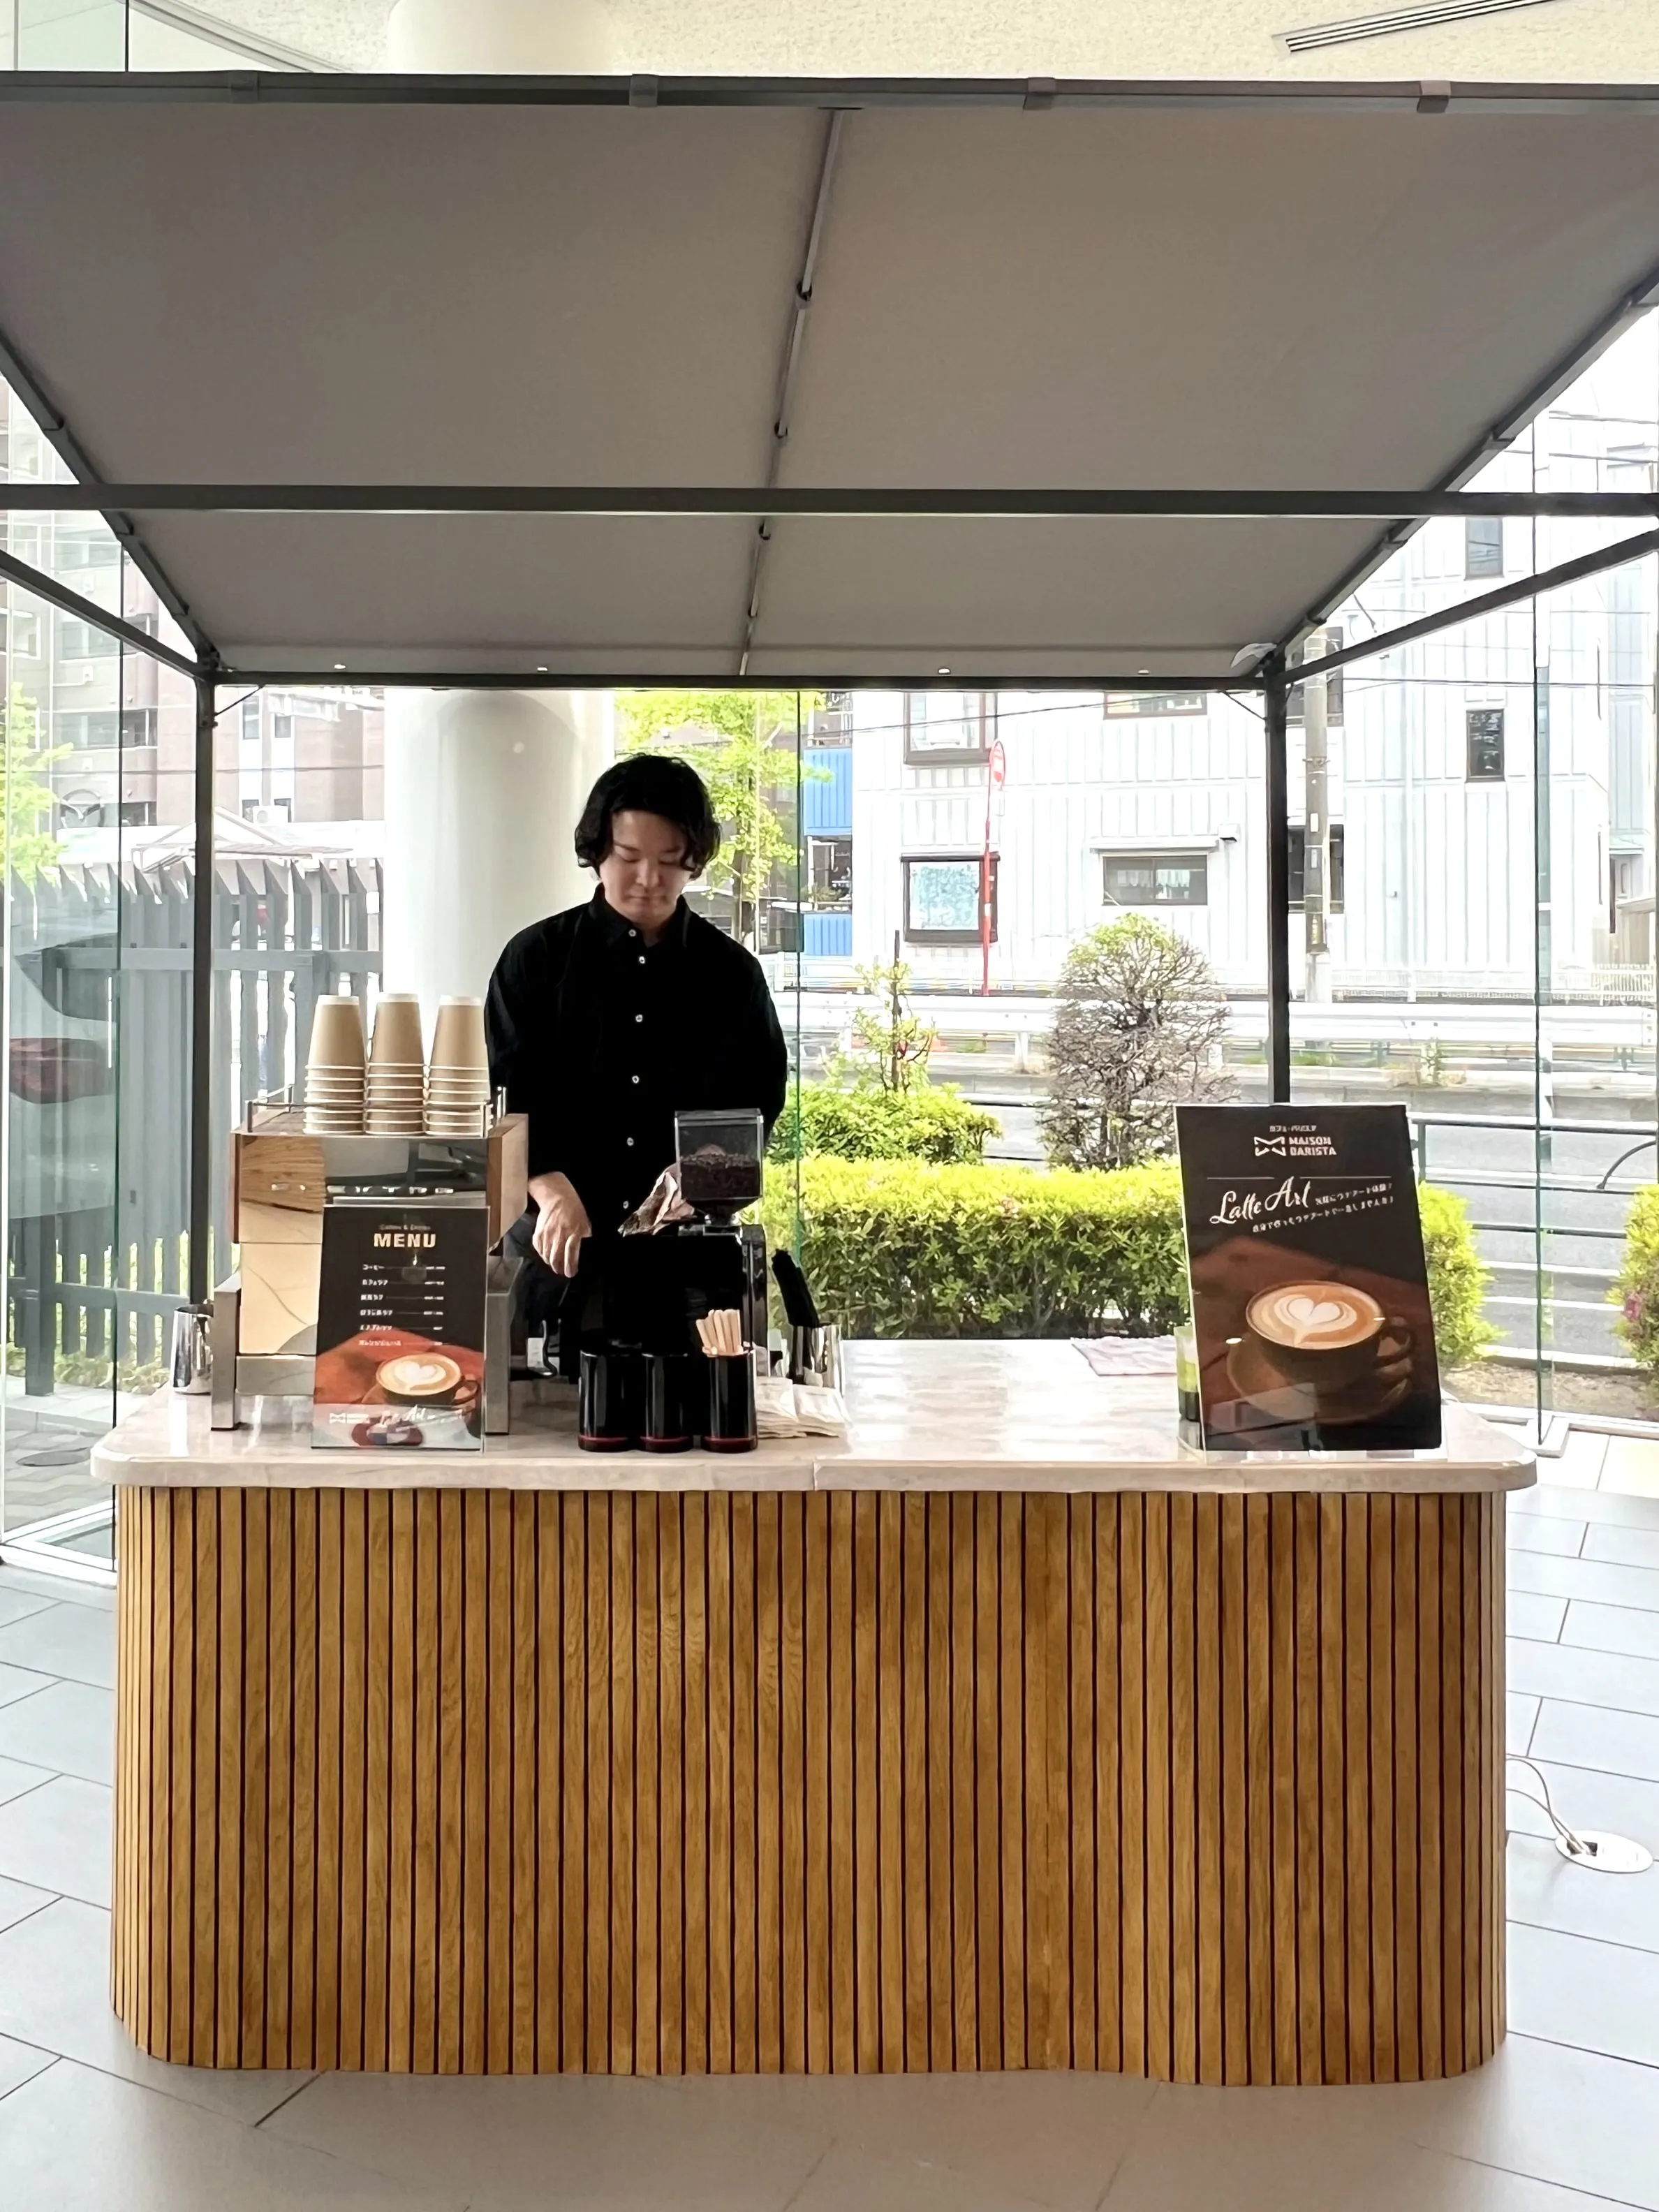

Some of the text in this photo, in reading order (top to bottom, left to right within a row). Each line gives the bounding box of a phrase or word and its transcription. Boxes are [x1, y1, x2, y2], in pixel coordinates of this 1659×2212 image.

[1288, 1136, 1332, 1145] MAISON
[1289, 1146, 1337, 1156] BARISTA
[1209, 1176, 1311, 1225] Latte Art
[374, 1232, 436, 1248] MENU
